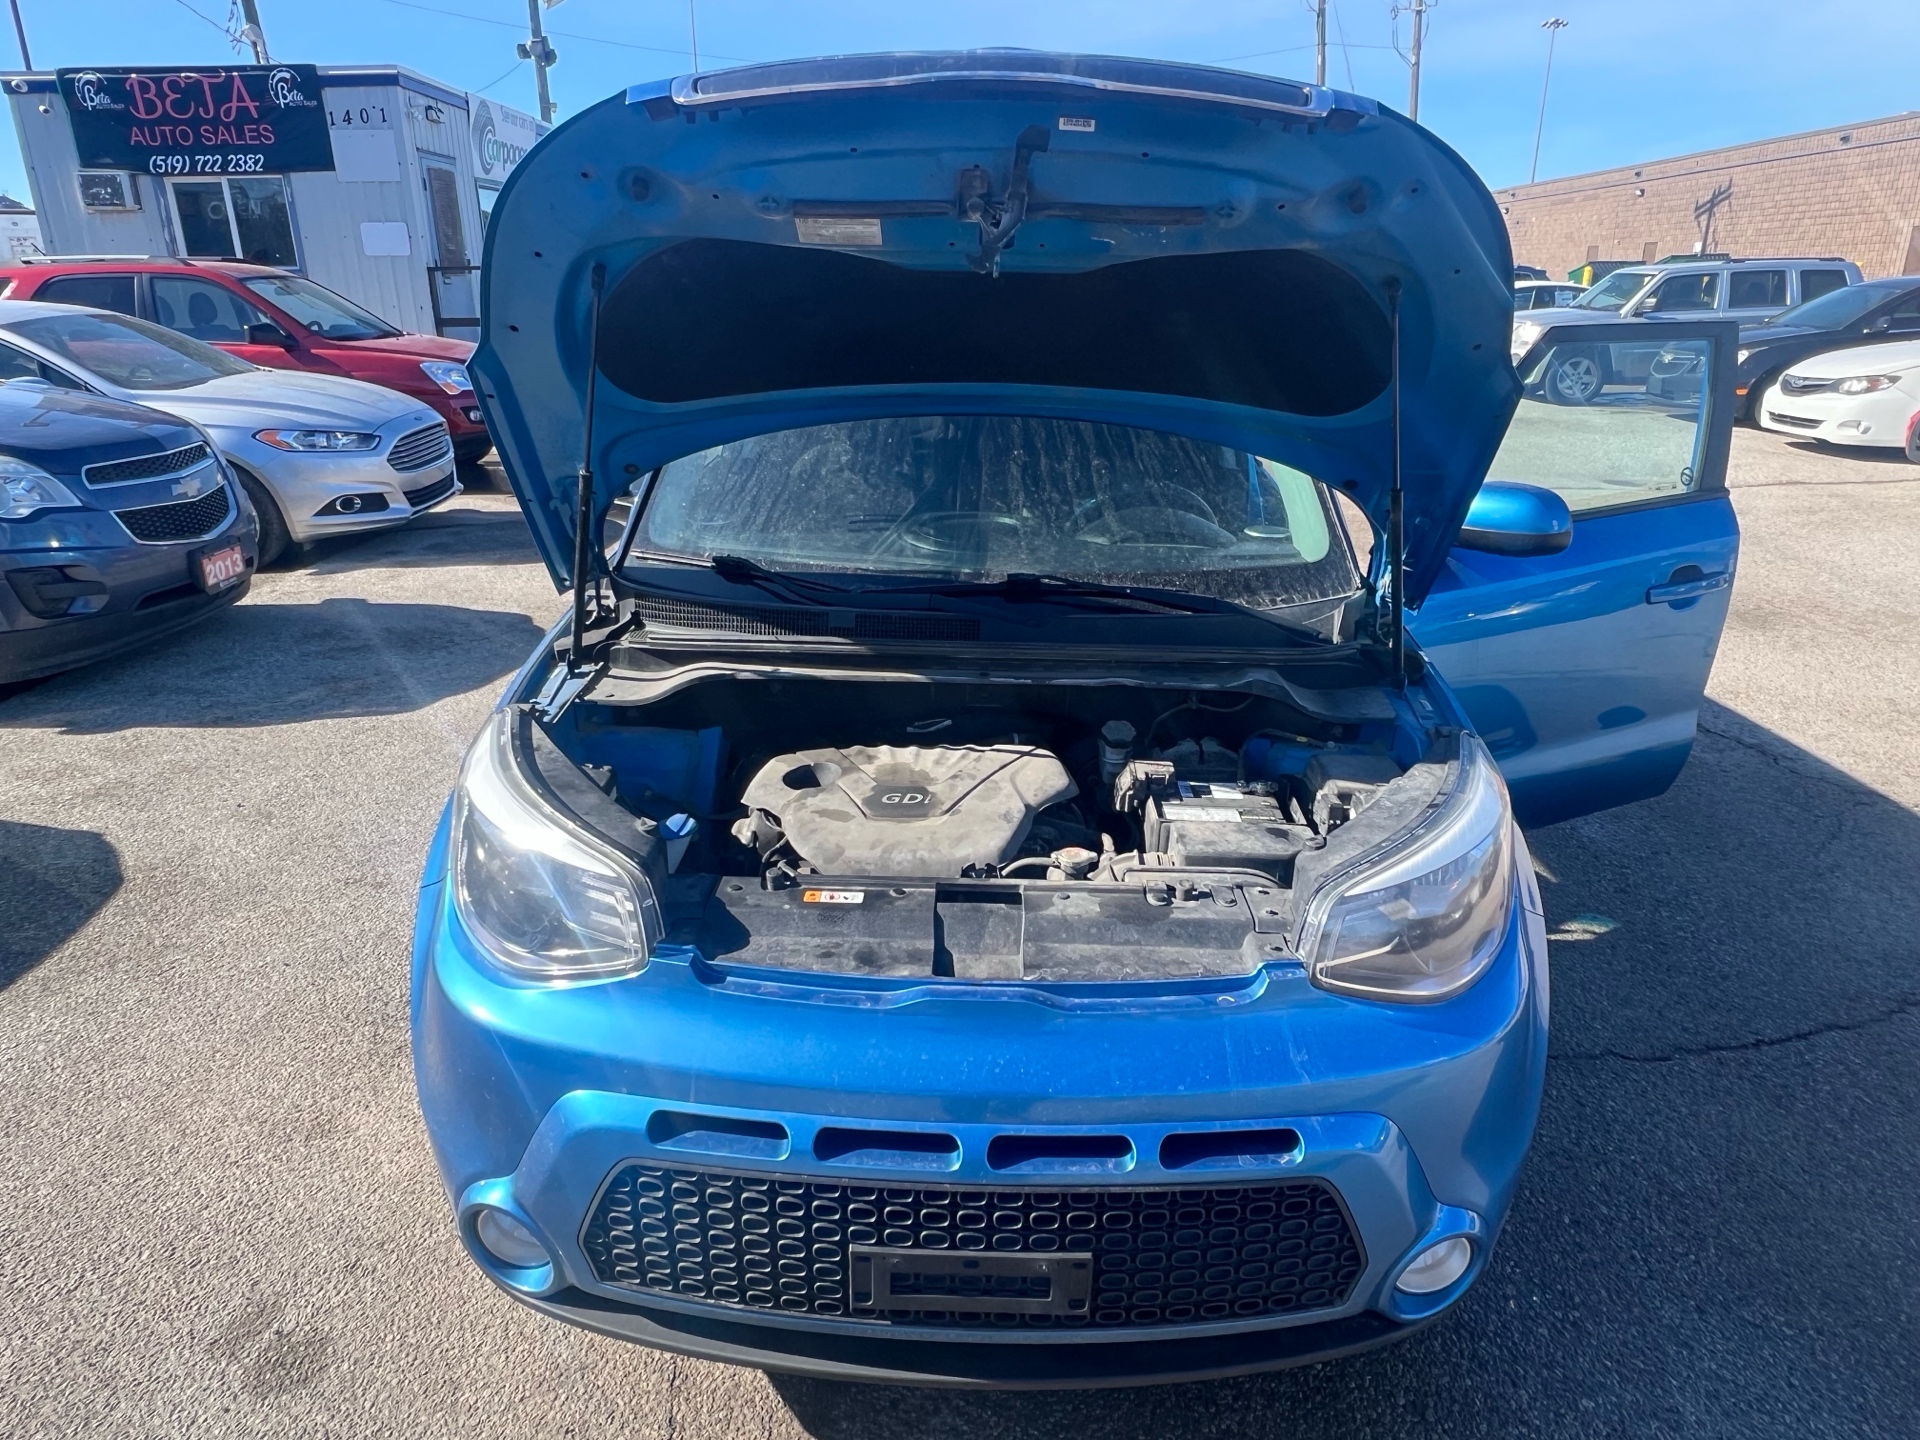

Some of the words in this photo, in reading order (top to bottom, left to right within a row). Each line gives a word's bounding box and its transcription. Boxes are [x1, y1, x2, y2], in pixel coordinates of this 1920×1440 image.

[84, 85, 111, 111] Beta
[125, 71, 260, 121] BETA
[277, 82, 304, 109] Beta
[130, 126, 194, 146] AUTO
[200, 124, 275, 145] SALES
[149, 155, 190, 174] (519)
[195, 154, 223, 172] 722
[227, 154, 265, 172] 2382
[206, 553, 243, 586] 2013
